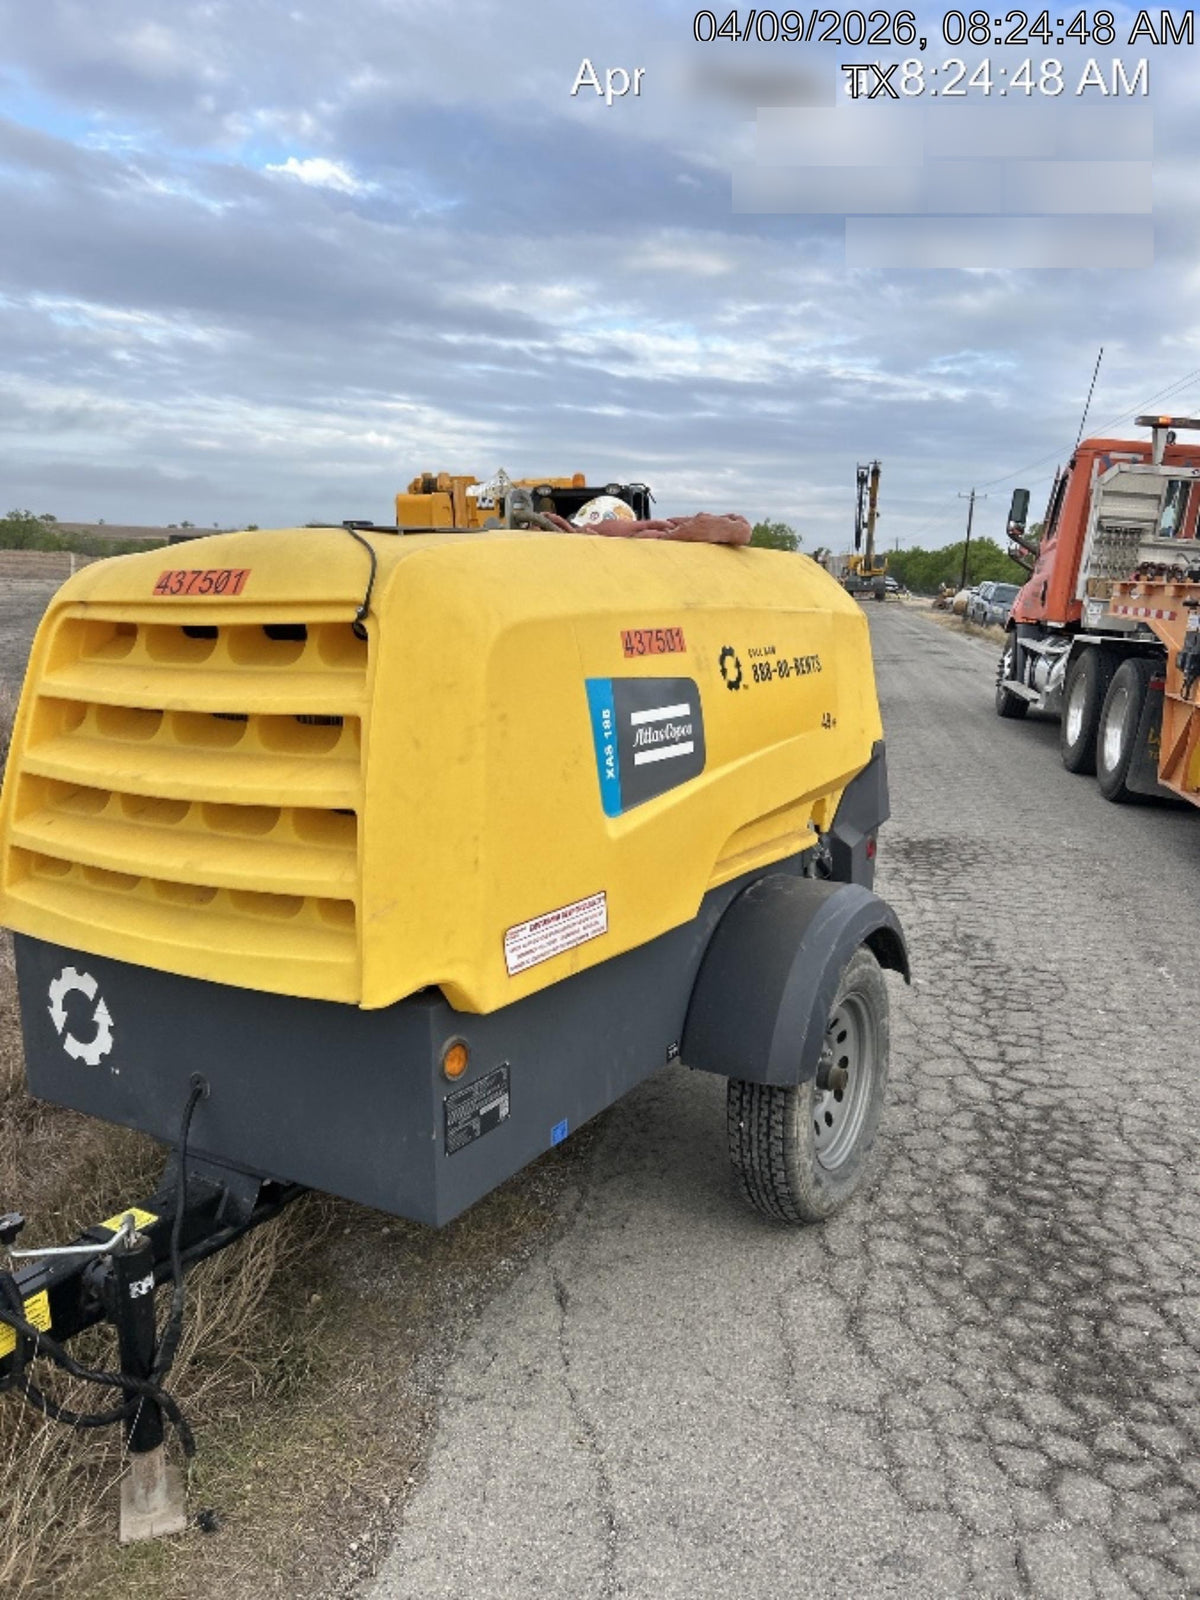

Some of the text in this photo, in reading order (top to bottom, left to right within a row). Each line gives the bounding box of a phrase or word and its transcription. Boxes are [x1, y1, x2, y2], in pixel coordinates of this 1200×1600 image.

[156, 569, 246, 594] 437501
[624, 628, 684, 655] 437501
[604, 744, 616, 780] XAS
